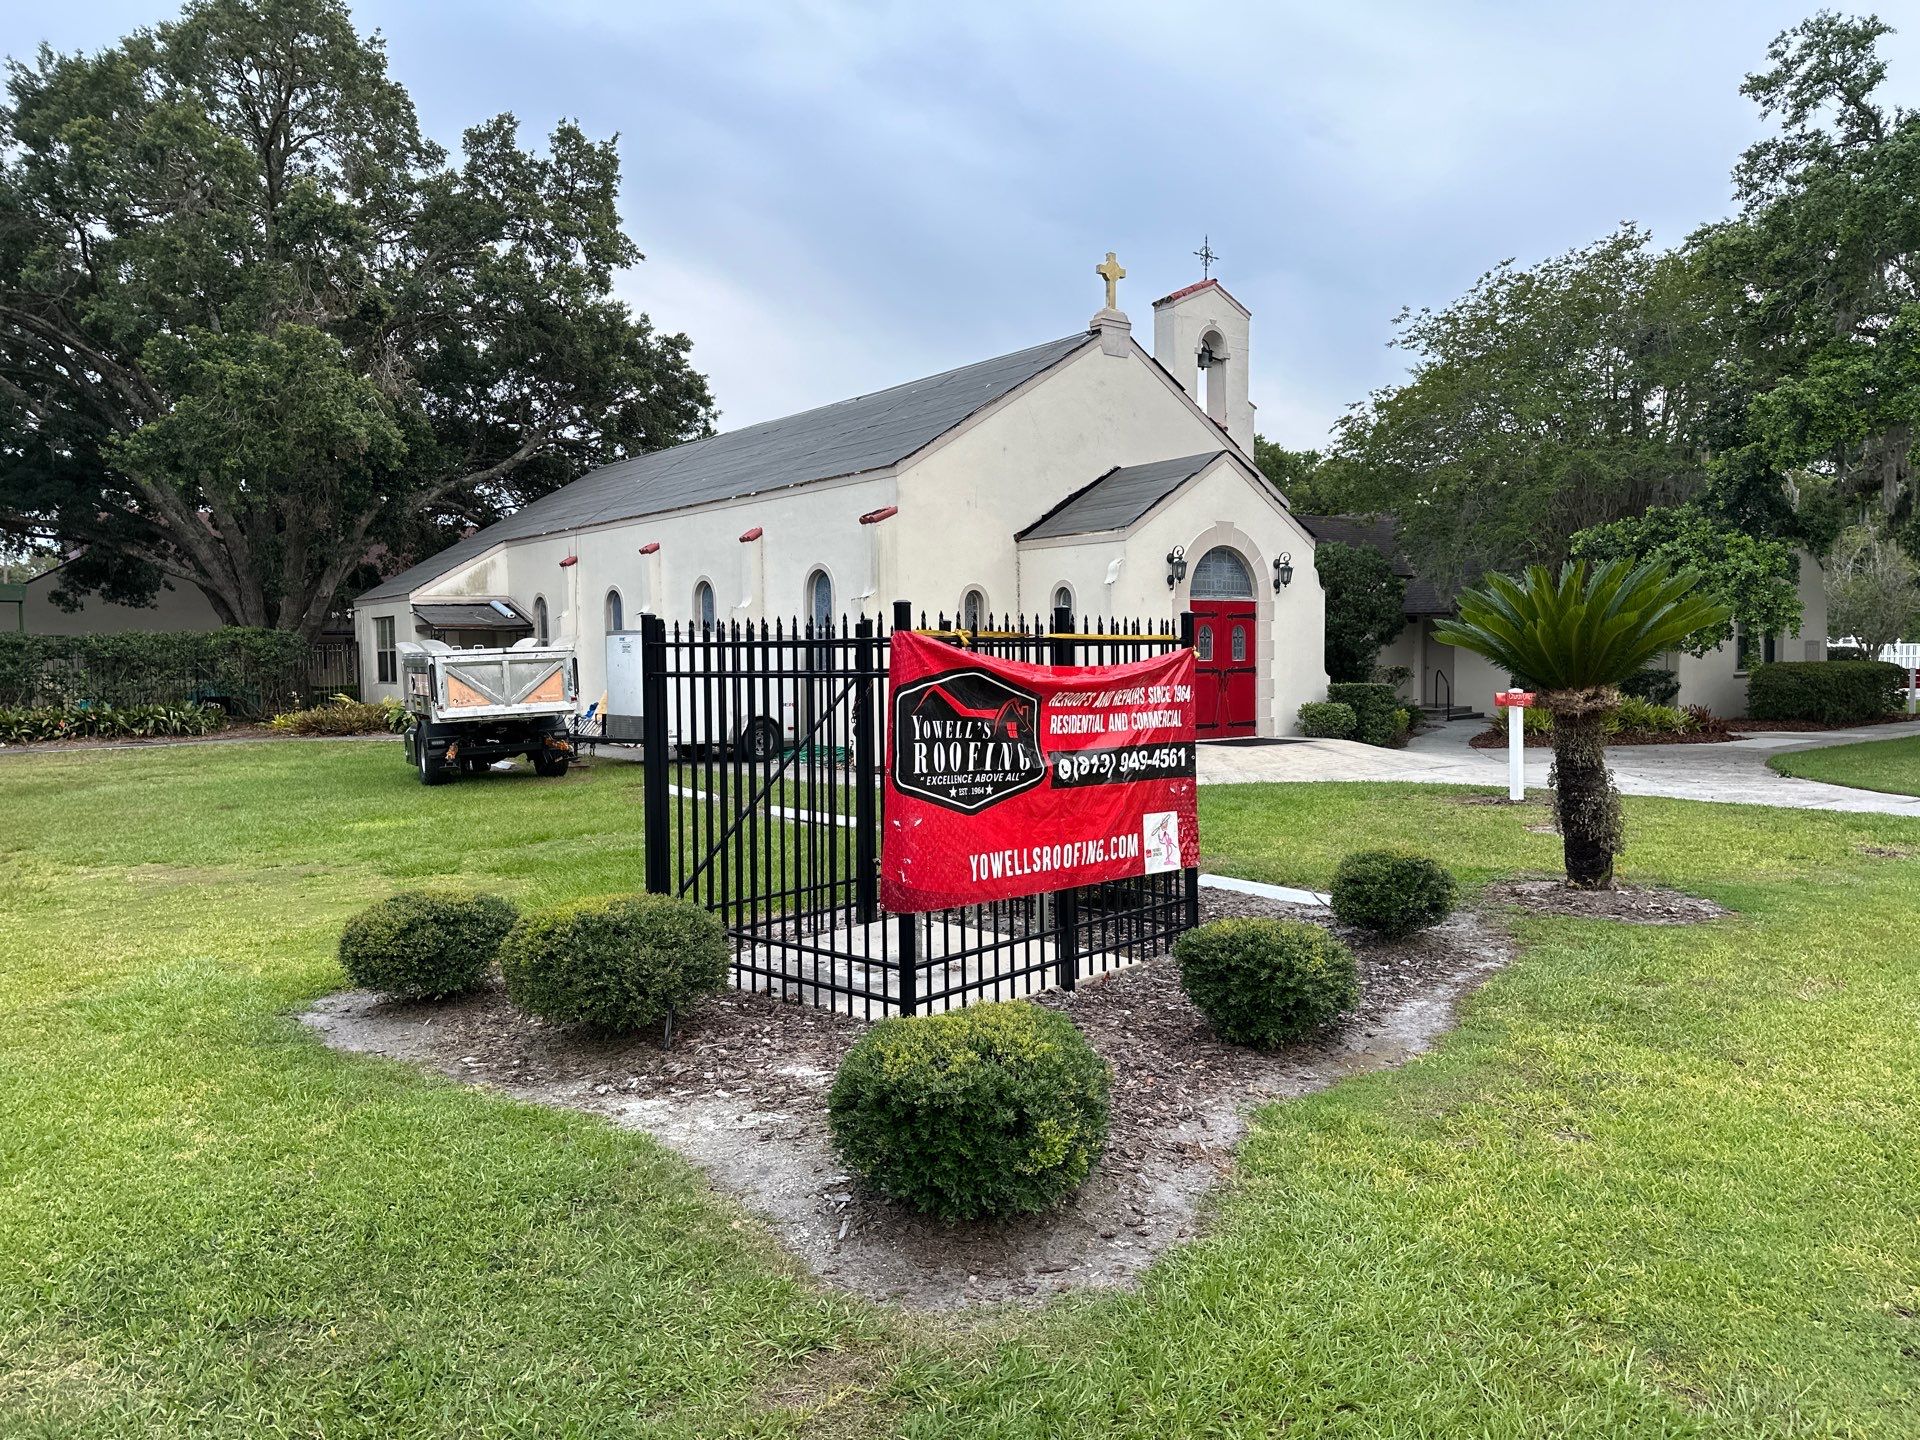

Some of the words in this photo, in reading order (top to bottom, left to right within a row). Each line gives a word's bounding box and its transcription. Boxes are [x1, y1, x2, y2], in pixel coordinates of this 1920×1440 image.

[1048, 691, 1096, 707] REROOFS
[1092, 690, 1115, 708] AND
[1112, 687, 1145, 706] REPAIRS
[1148, 685, 1171, 704] SINCE
[1173, 685, 1191, 703] 1964
[910, 715, 992, 740] YOWELL'S
[1049, 713, 1106, 735] RESIDENTIAL
[1108, 712, 1129, 733] AND
[1131, 709, 1182, 730] COMMERCIAL
[912, 741, 1031, 774] ROOFING
[1073, 753, 1117, 781] (813)
[1119, 747, 1186, 773] 949-4561
[975, 772, 1003, 783] ABOVE
[971, 786, 985, 796] 1964
[968, 832, 1139, 883] YOWELLSROOFING.COM
